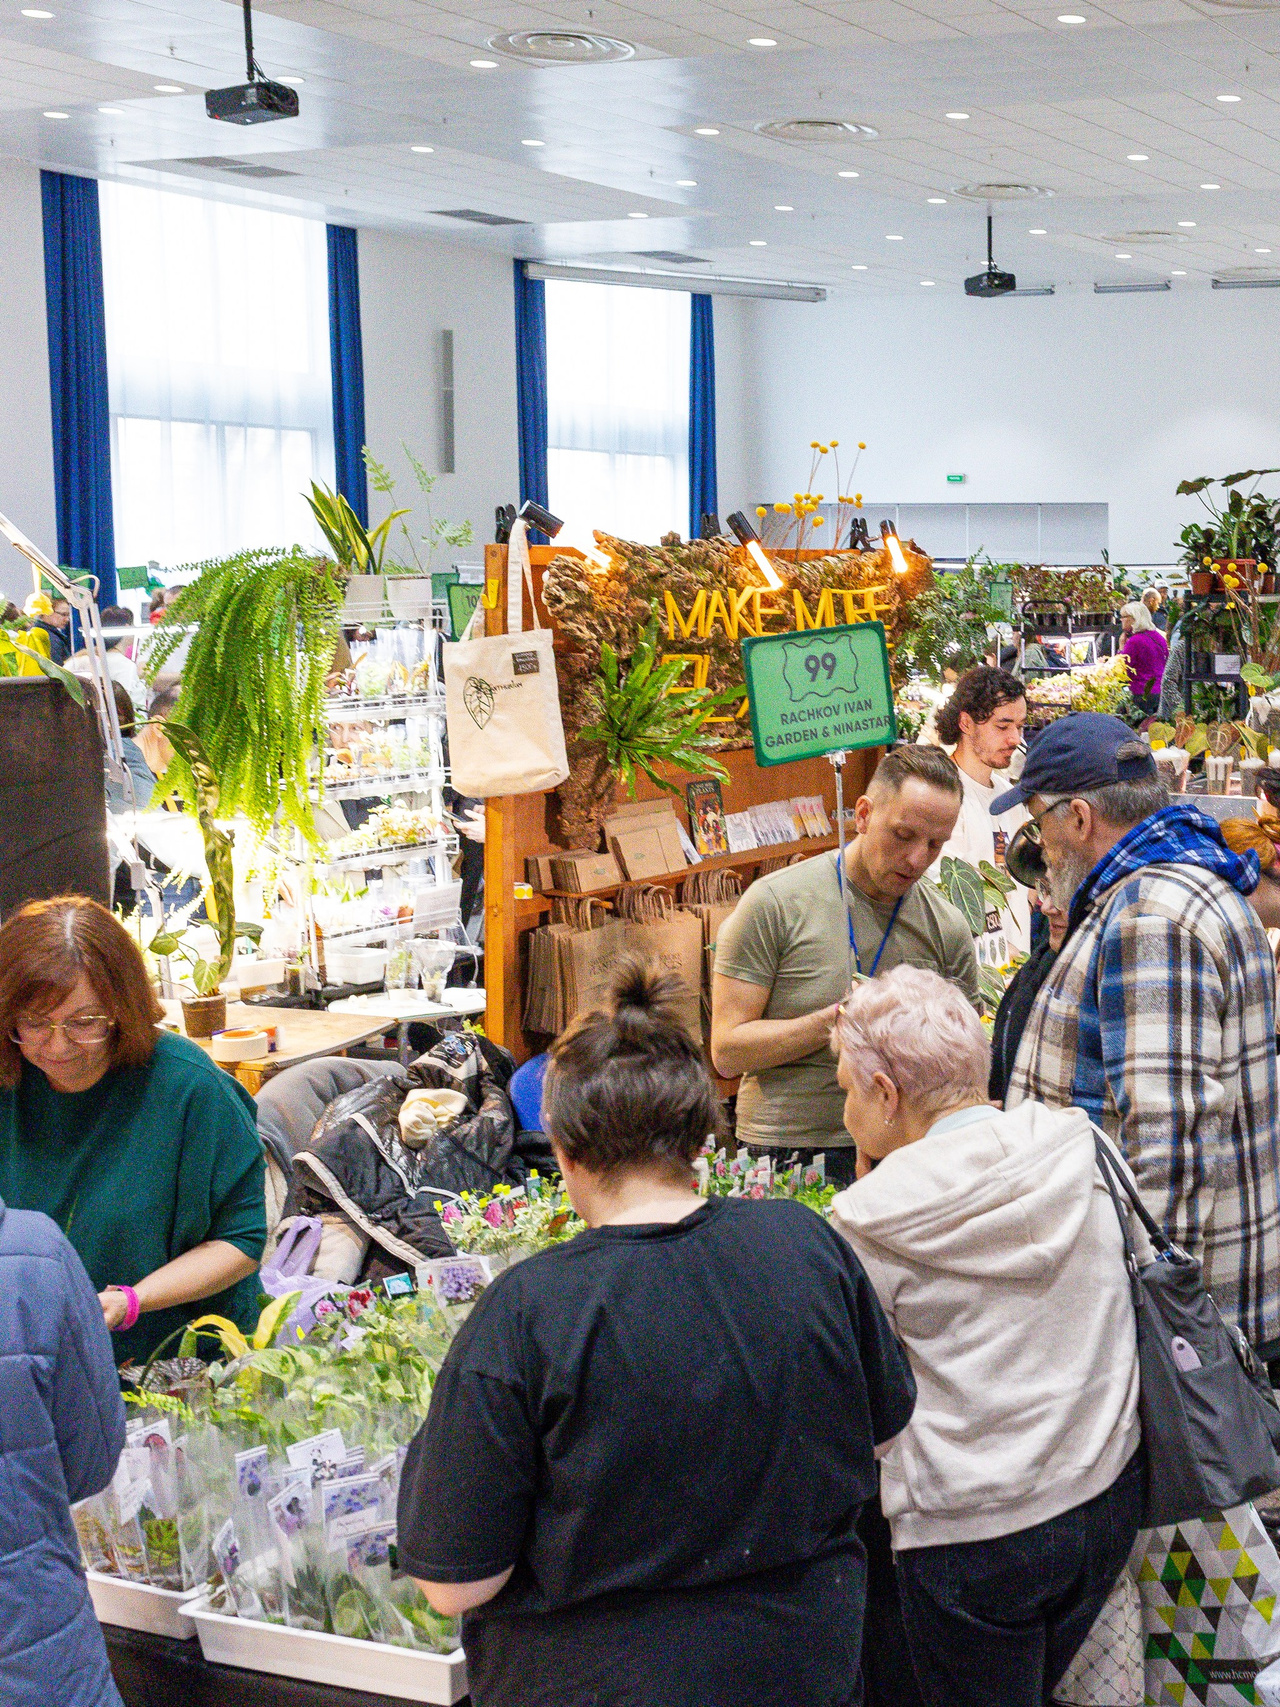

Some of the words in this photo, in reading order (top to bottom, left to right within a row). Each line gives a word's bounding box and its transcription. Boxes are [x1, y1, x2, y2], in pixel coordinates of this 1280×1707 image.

[664, 586, 784, 640] MAKE
[805, 652, 837, 682] 99
[780, 704, 841, 725] RACHKOV
[844, 699, 873, 715] IVAN
[765, 728, 823, 748] GARDEN
[822, 725, 830, 738] &
[833, 714, 891, 736] NINASTAR
